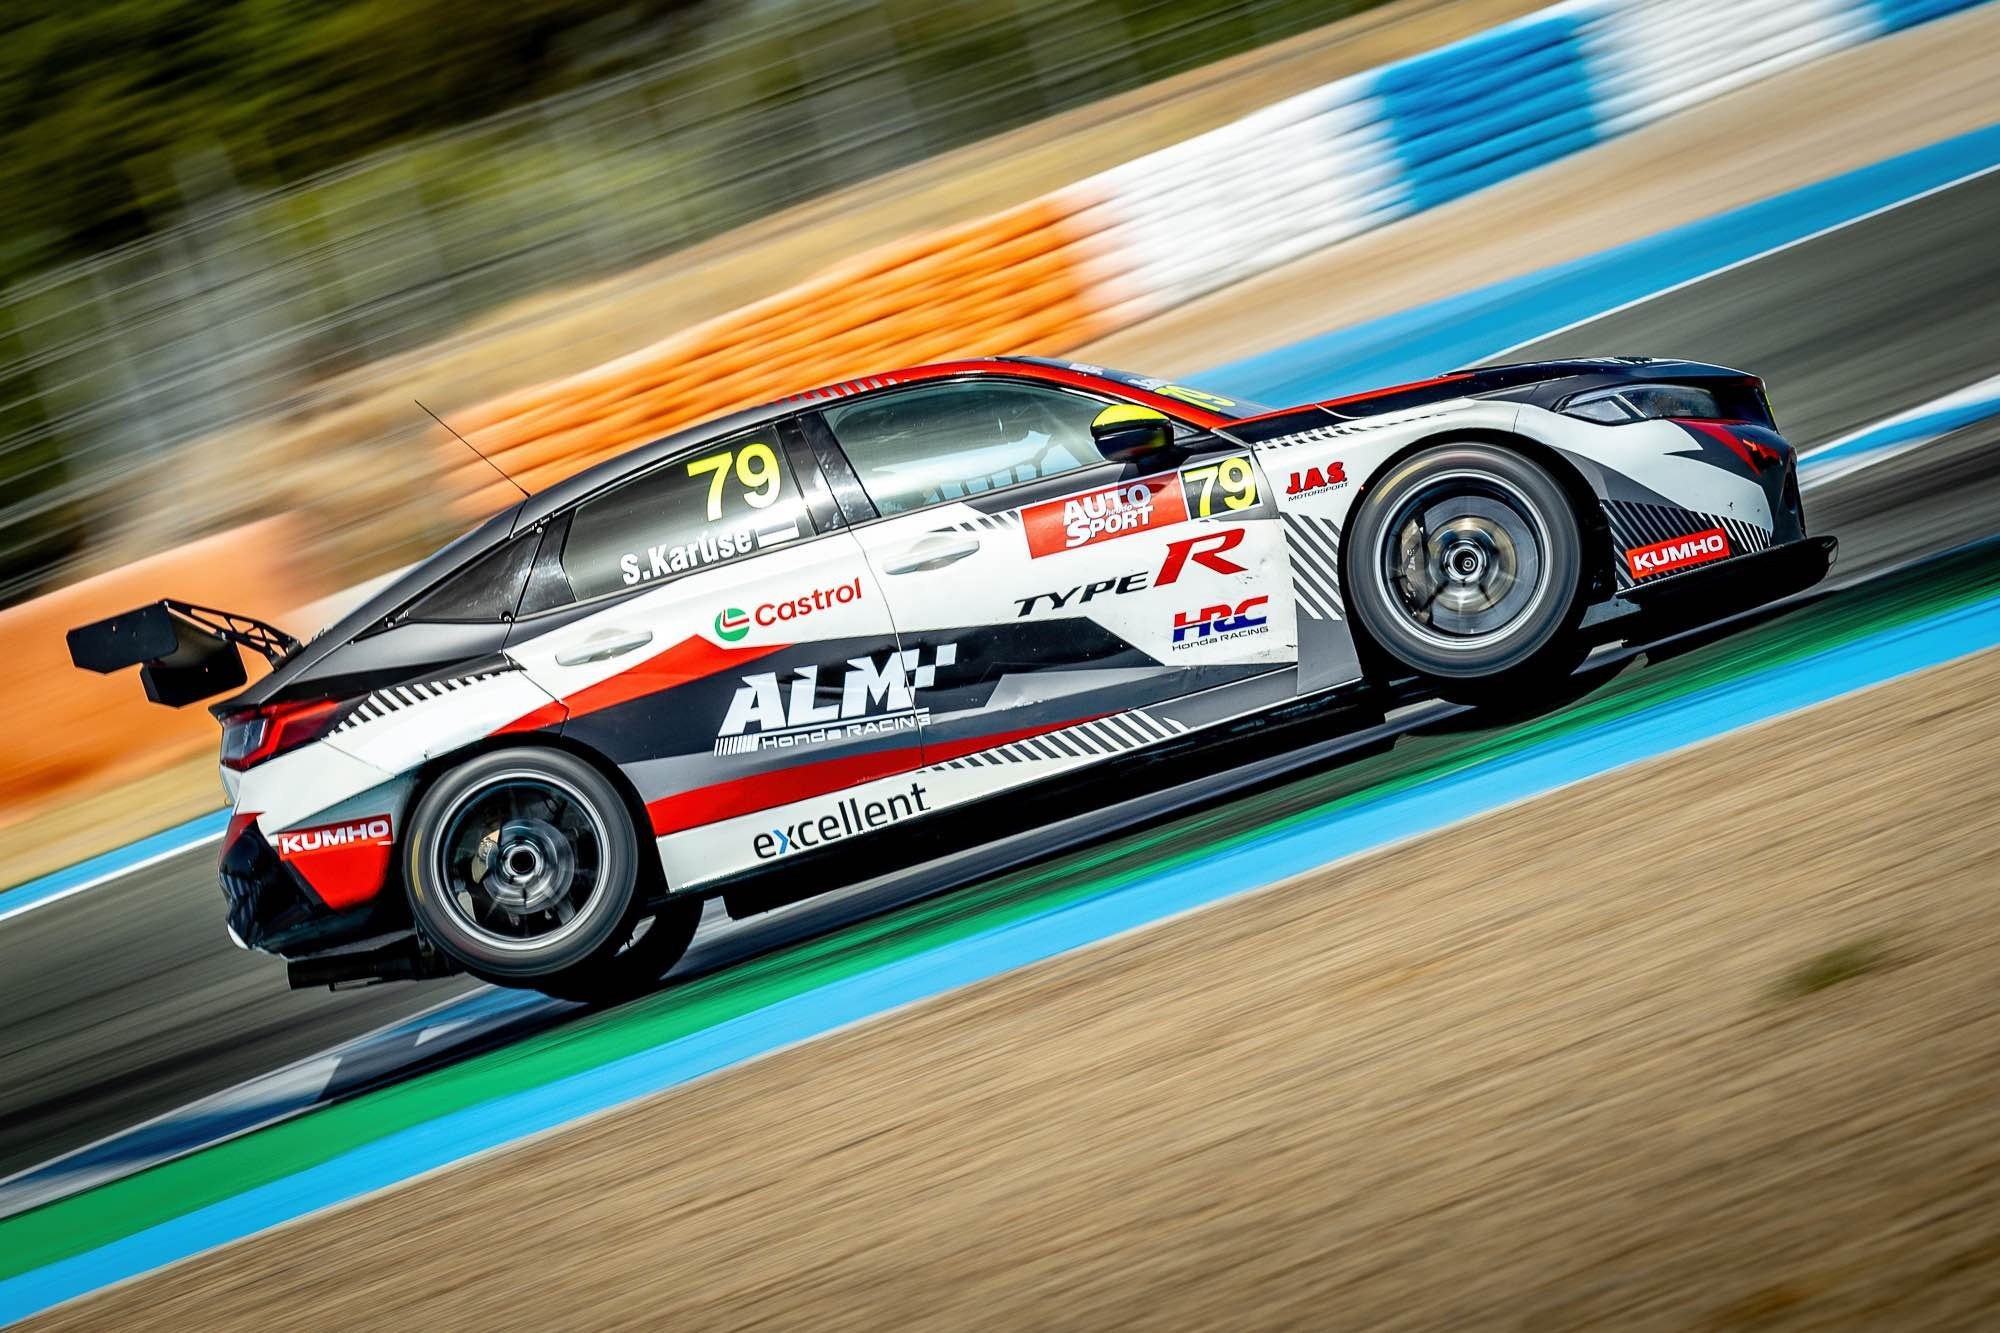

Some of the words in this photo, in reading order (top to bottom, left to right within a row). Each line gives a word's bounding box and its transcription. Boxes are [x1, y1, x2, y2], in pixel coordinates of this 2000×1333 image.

[687, 443, 782, 522] 79
[1063, 484, 1152, 526] AUTO
[1184, 457, 1256, 516] 79
[1288, 482, 1350, 501] MOTORSPORT
[1066, 505, 1154, 548] SPORT
[1014, 571, 1149, 618] TYPE
[1153, 528, 1248, 588] R
[1631, 534, 1726, 571] KUMHO
[754, 577, 863, 627] Castrol
[1173, 595, 1268, 643] HRC
[1172, 637, 1218, 652] Honda
[1220, 626, 1269, 642] RACING
[717, 648, 921, 737] ALM
[761, 728, 843, 750] Honda
[846, 712, 932, 738] RACING
[281, 819, 389, 855] KUMHO
[753, 782, 932, 859] excellent
